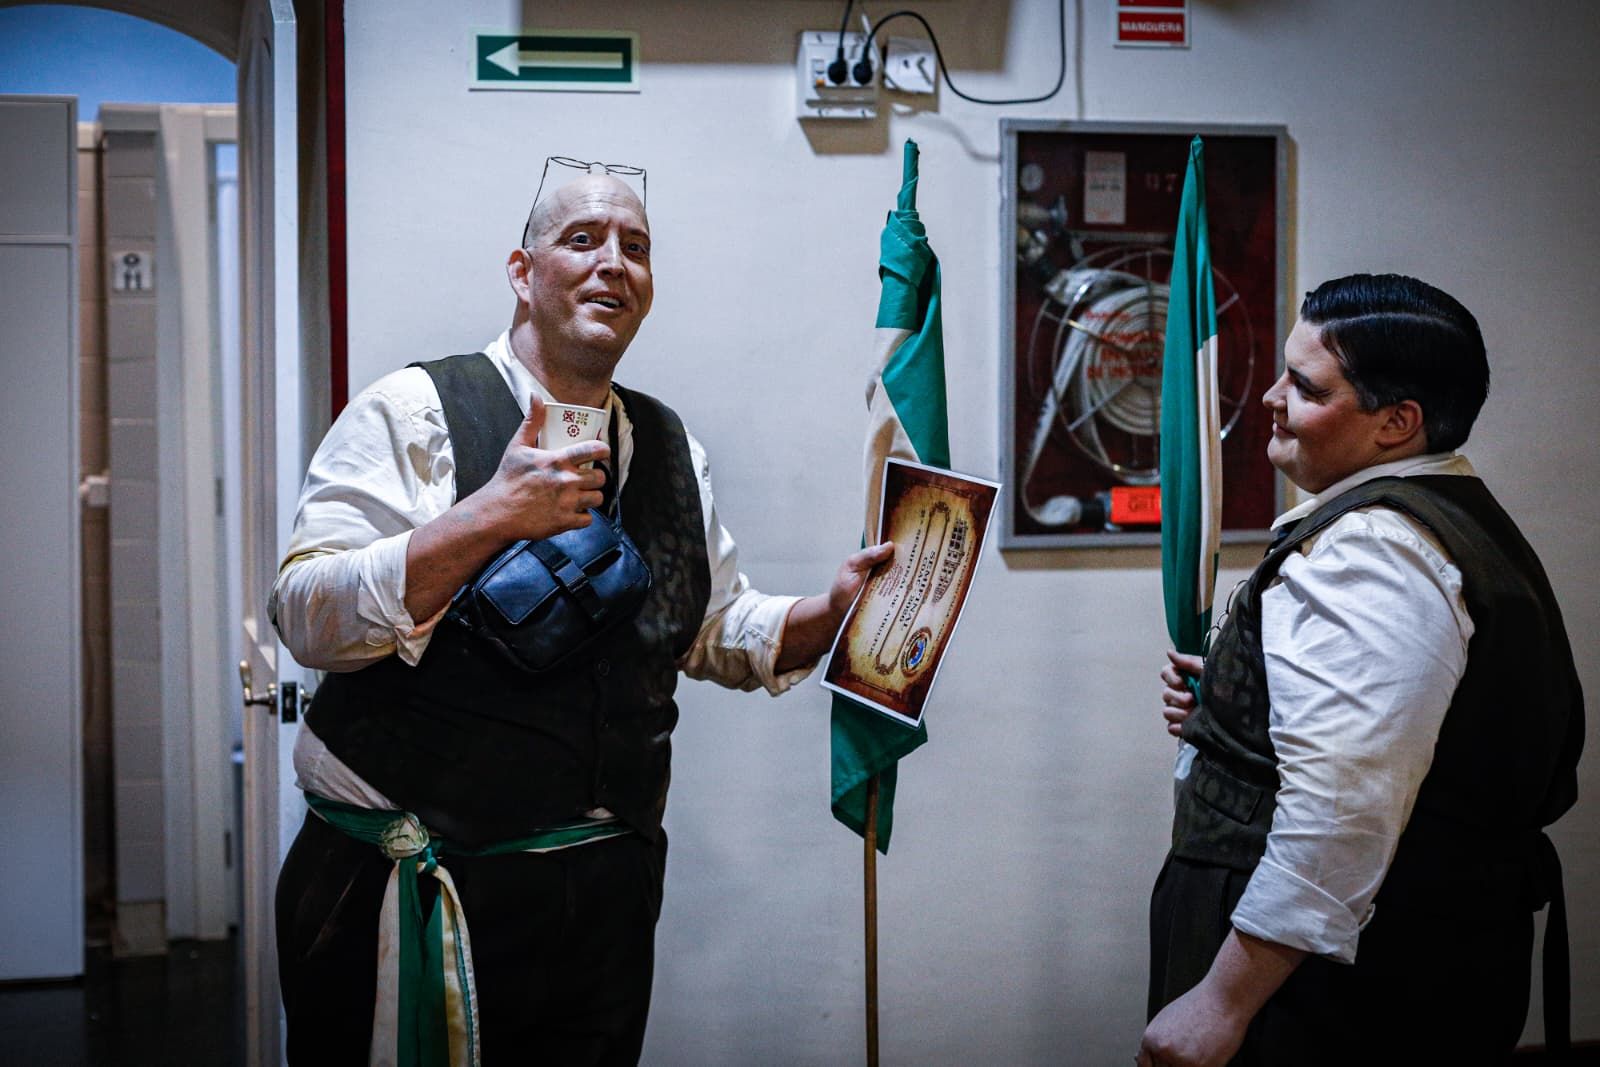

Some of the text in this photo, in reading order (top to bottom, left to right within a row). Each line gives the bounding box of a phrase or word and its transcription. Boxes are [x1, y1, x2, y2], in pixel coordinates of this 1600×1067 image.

[1120, 22, 1183, 33] MANGUERA
[898, 529, 922, 590] SEMIFINAL
[915, 556, 928, 585] COAC
[889, 594, 899, 608] DE
[900, 550, 936, 632] SEMIFINAL
